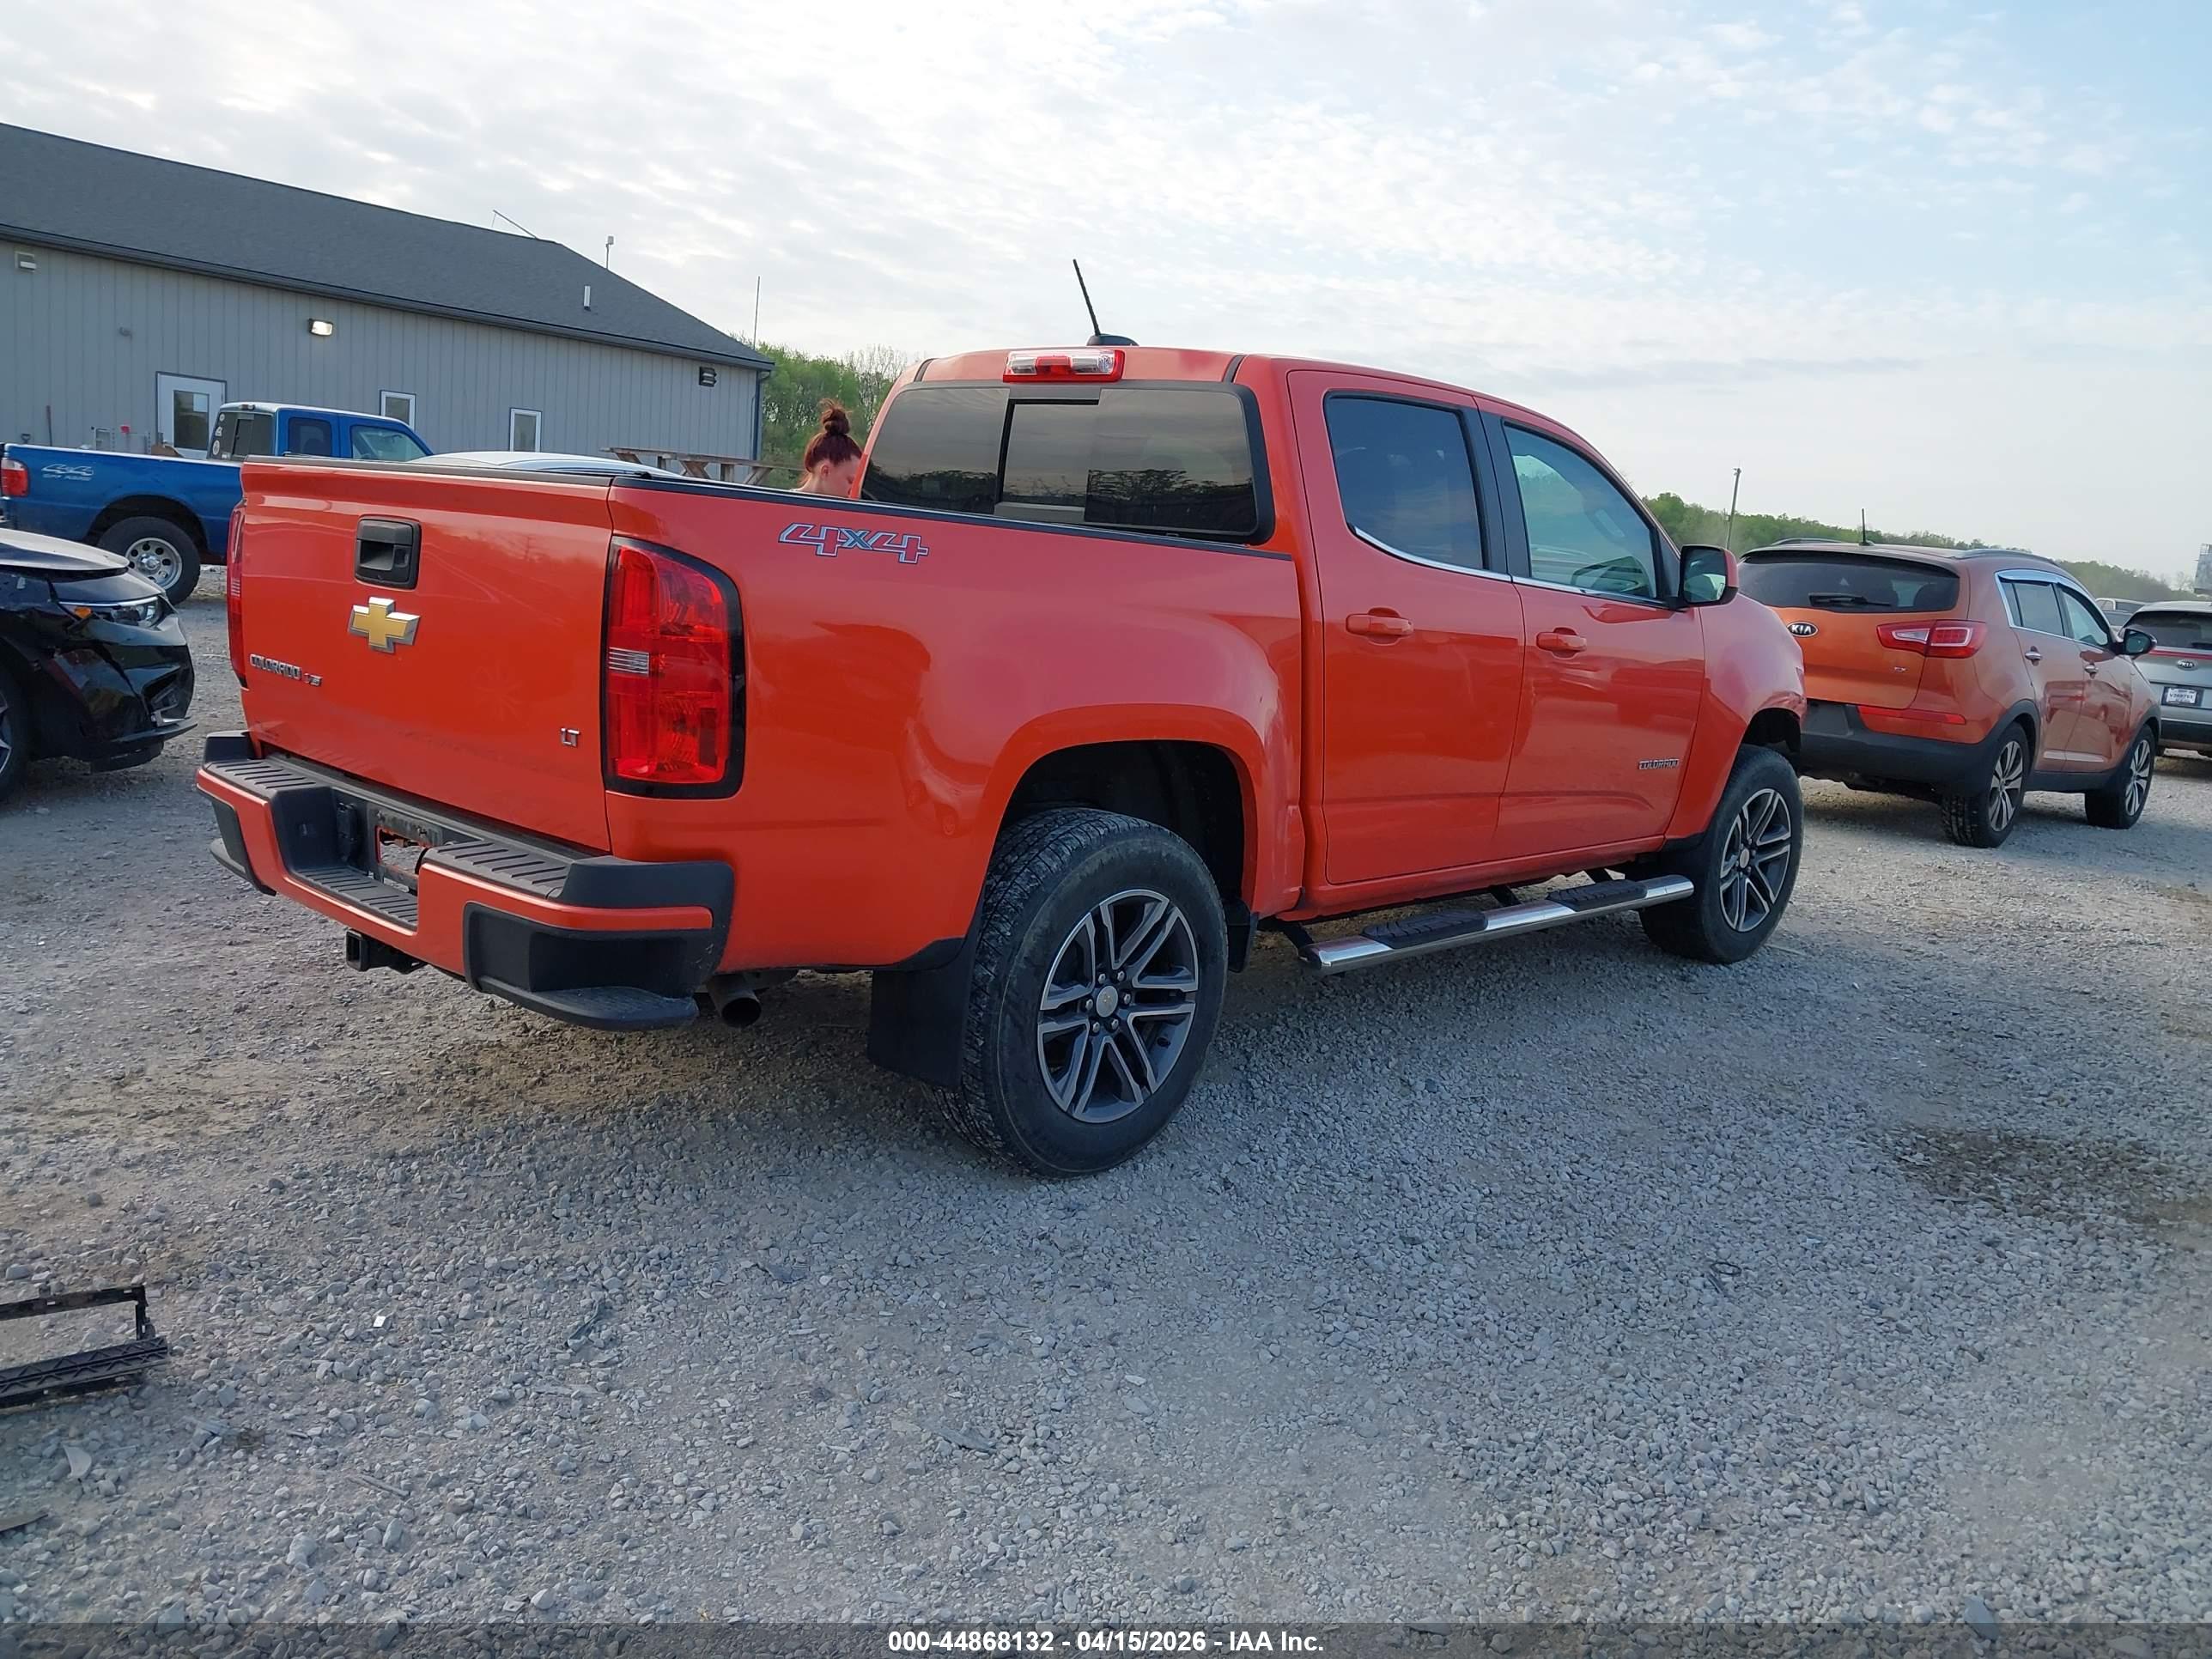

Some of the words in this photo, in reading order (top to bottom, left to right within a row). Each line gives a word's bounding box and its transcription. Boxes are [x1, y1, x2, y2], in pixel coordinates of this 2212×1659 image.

[1790, 623, 1814, 635] KIA
[249, 653, 303, 681] COLORADO
[560, 727, 580, 748] LT
[1638, 758, 1680, 770] COLORADO
